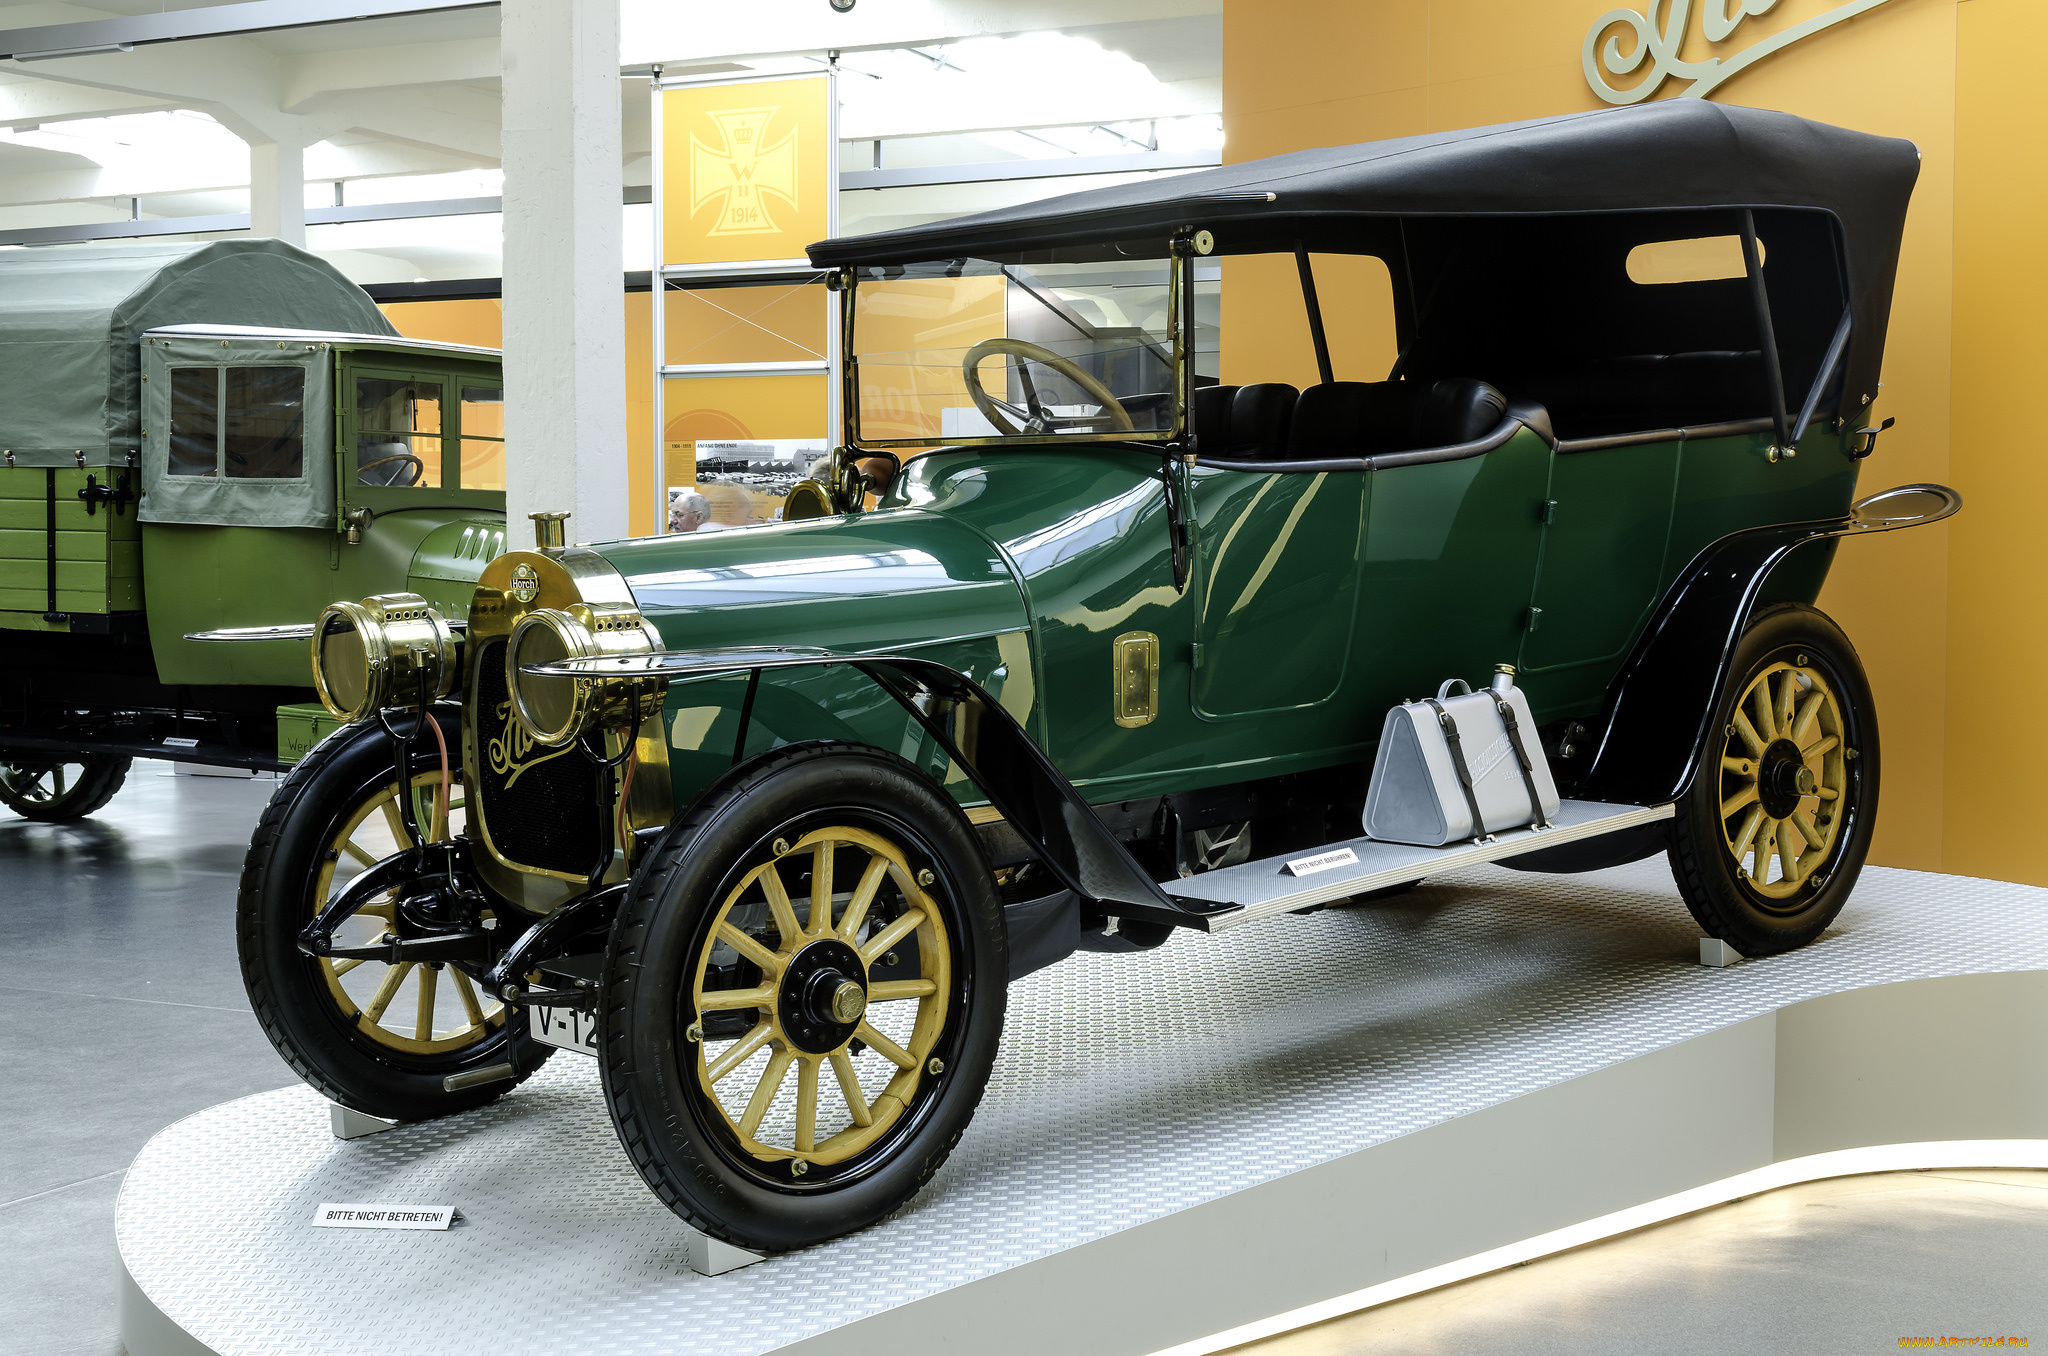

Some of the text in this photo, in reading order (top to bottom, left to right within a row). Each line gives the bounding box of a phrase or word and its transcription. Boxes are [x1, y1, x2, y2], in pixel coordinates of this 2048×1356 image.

[728, 161, 759, 182] W
[731, 207, 758, 223] 1914
[512, 578, 535, 589] Horch
[1293, 862, 1310, 871] BITTE
[1308, 858, 1325, 868] NICHT
[326, 1210, 443, 1222] BITTE NICHT BETRETEN!
